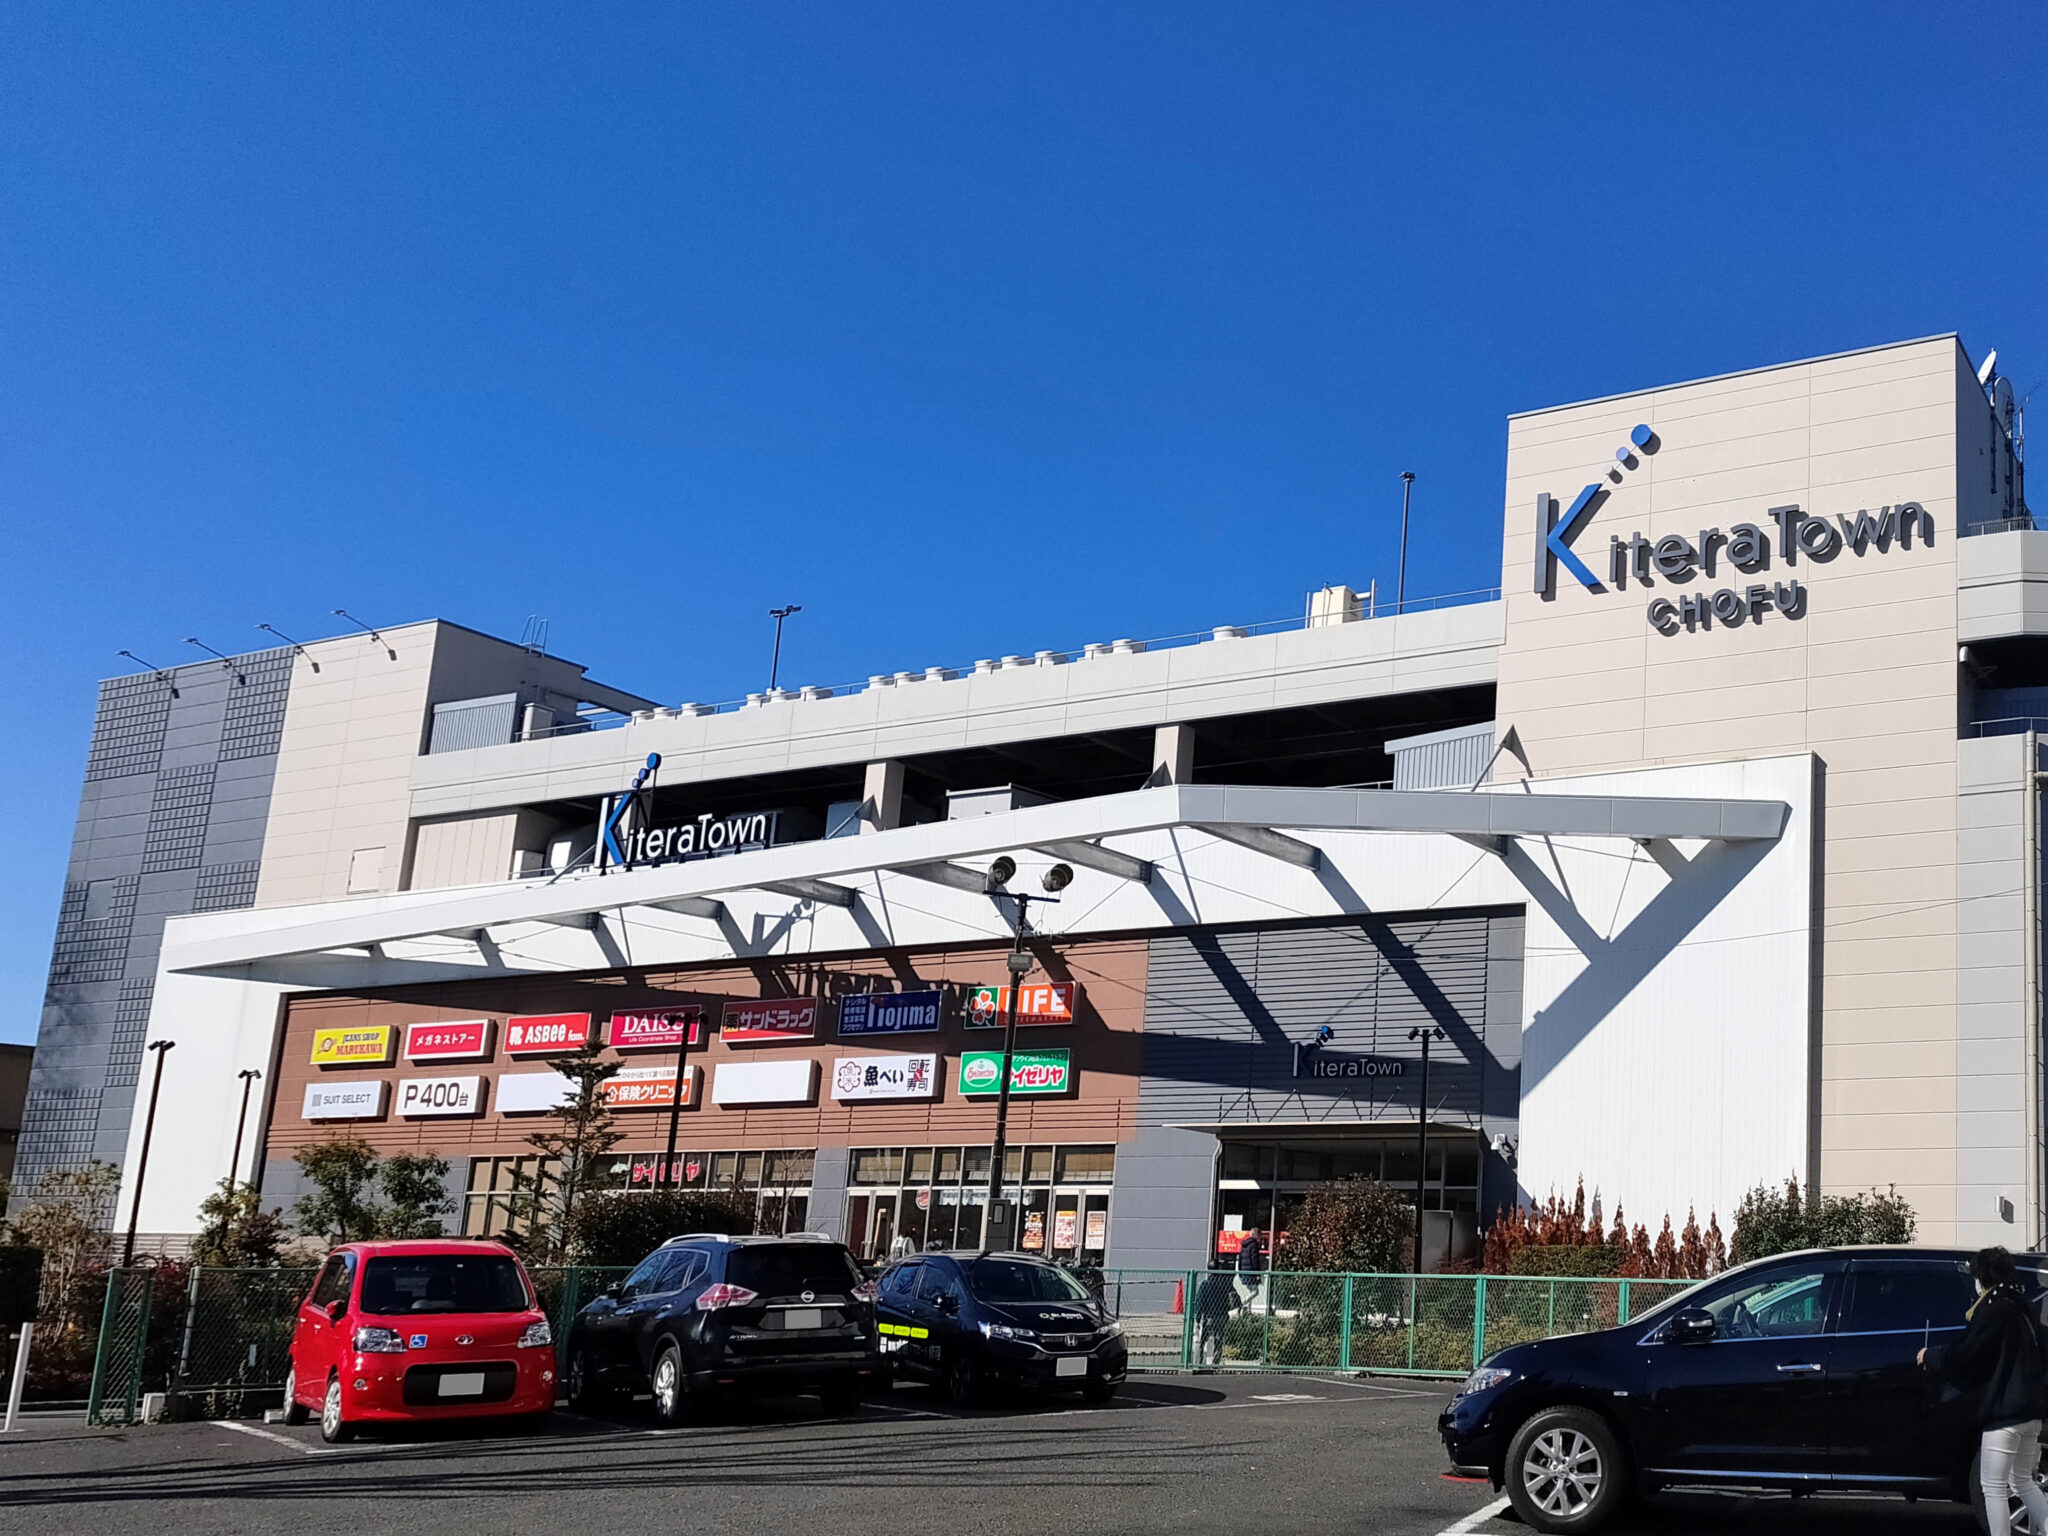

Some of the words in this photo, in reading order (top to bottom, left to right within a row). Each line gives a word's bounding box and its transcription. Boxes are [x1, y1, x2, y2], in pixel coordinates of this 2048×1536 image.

[1534, 482, 1926, 594] KiteraTown
[1647, 579, 1802, 632] CHOFU
[594, 792, 767, 867] KiteraTown
[740, 1007, 814, 1031] サンドラッグ
[362, 1032, 380, 1041] SHOP
[415, 1032, 476, 1047] メガネストアー
[524, 1023, 567, 1044] ASBee
[335, 1043, 383, 1056] MARUKAWA
[863, 1065, 904, 1087] 魚べい
[323, 1095, 341, 1105] SUIT
[341, 1093, 372, 1104] SELECT
